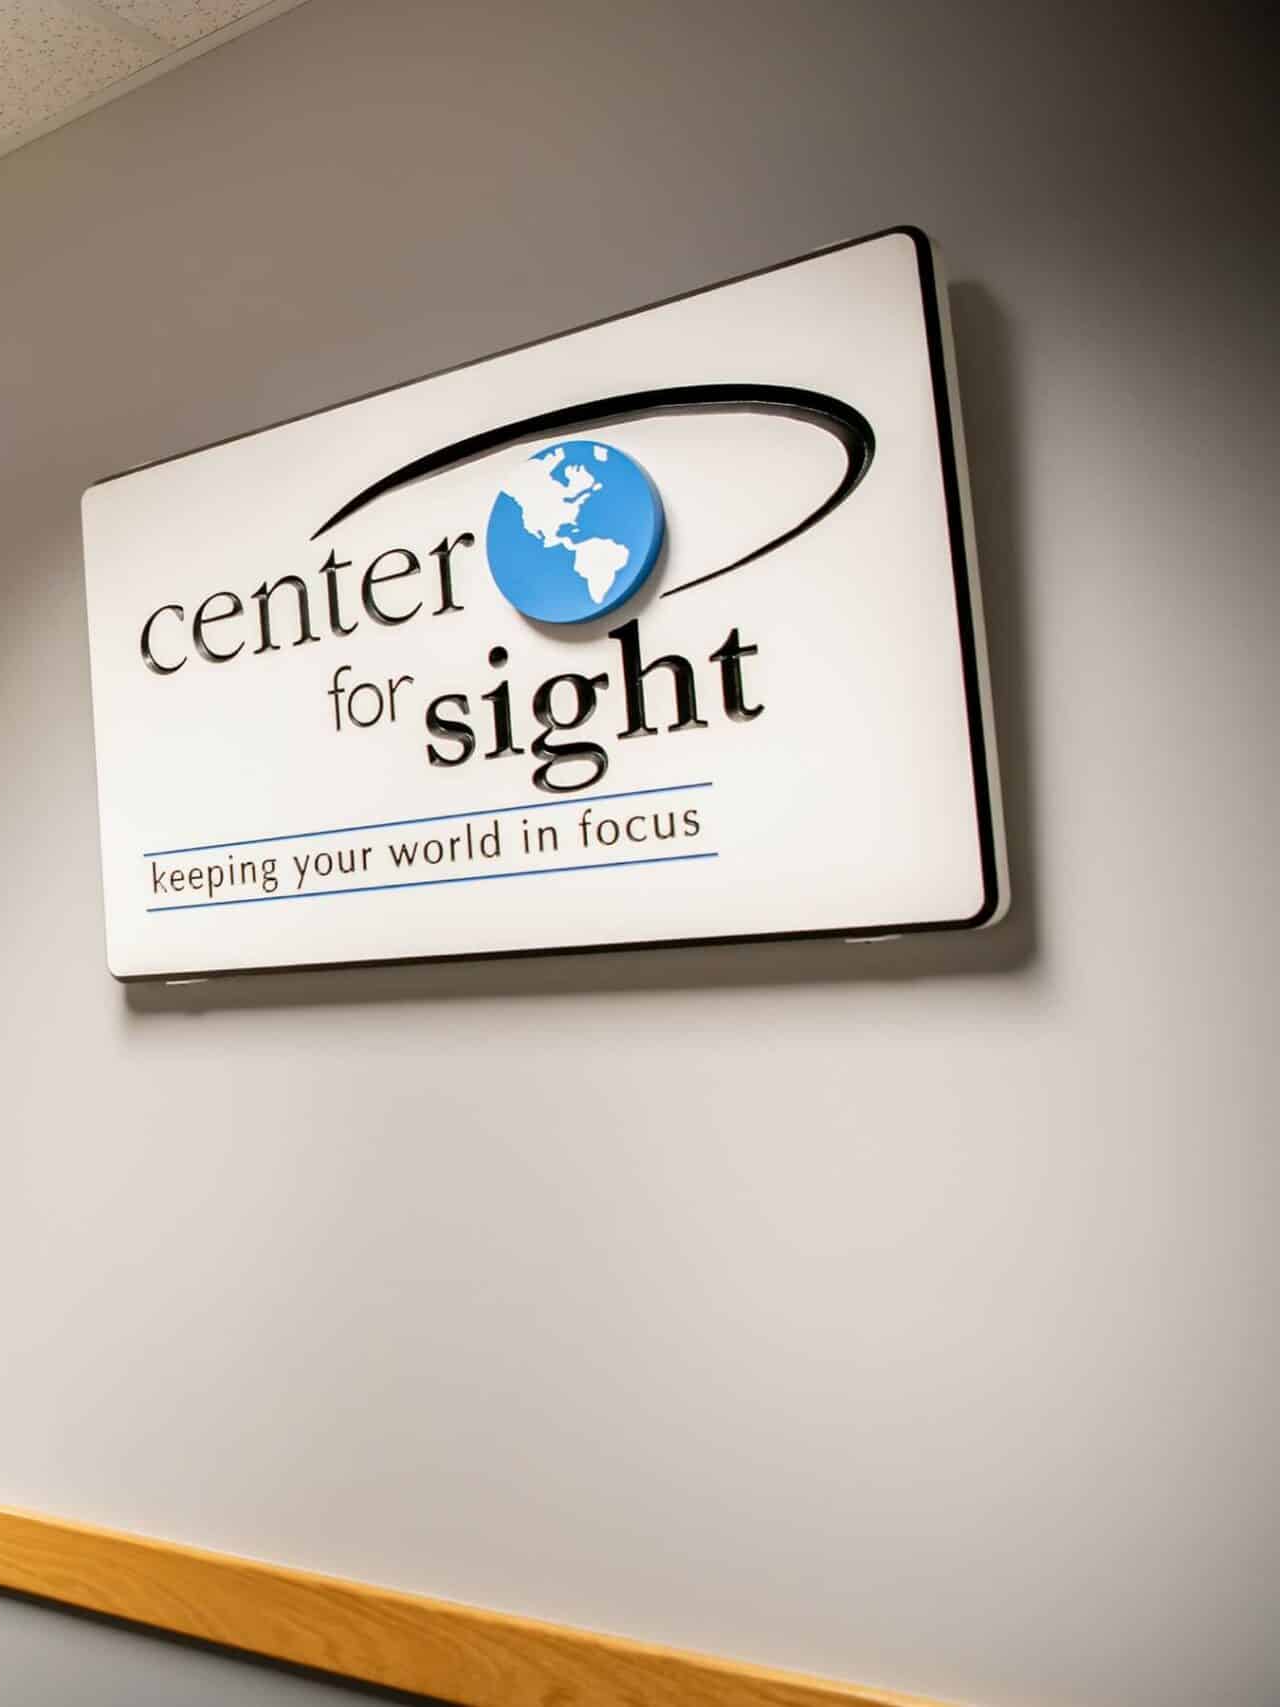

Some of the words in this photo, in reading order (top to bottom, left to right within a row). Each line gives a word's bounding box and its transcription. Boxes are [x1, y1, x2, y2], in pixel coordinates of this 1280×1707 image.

[140, 532, 475, 676] center
[328, 665, 414, 731] for
[425, 618, 765, 793] sight
[151, 855, 278, 898] keeping
[292, 845, 373, 889] your
[389, 820, 502, 867] world
[522, 819, 559, 854] in
[579, 808, 701, 847] focus
